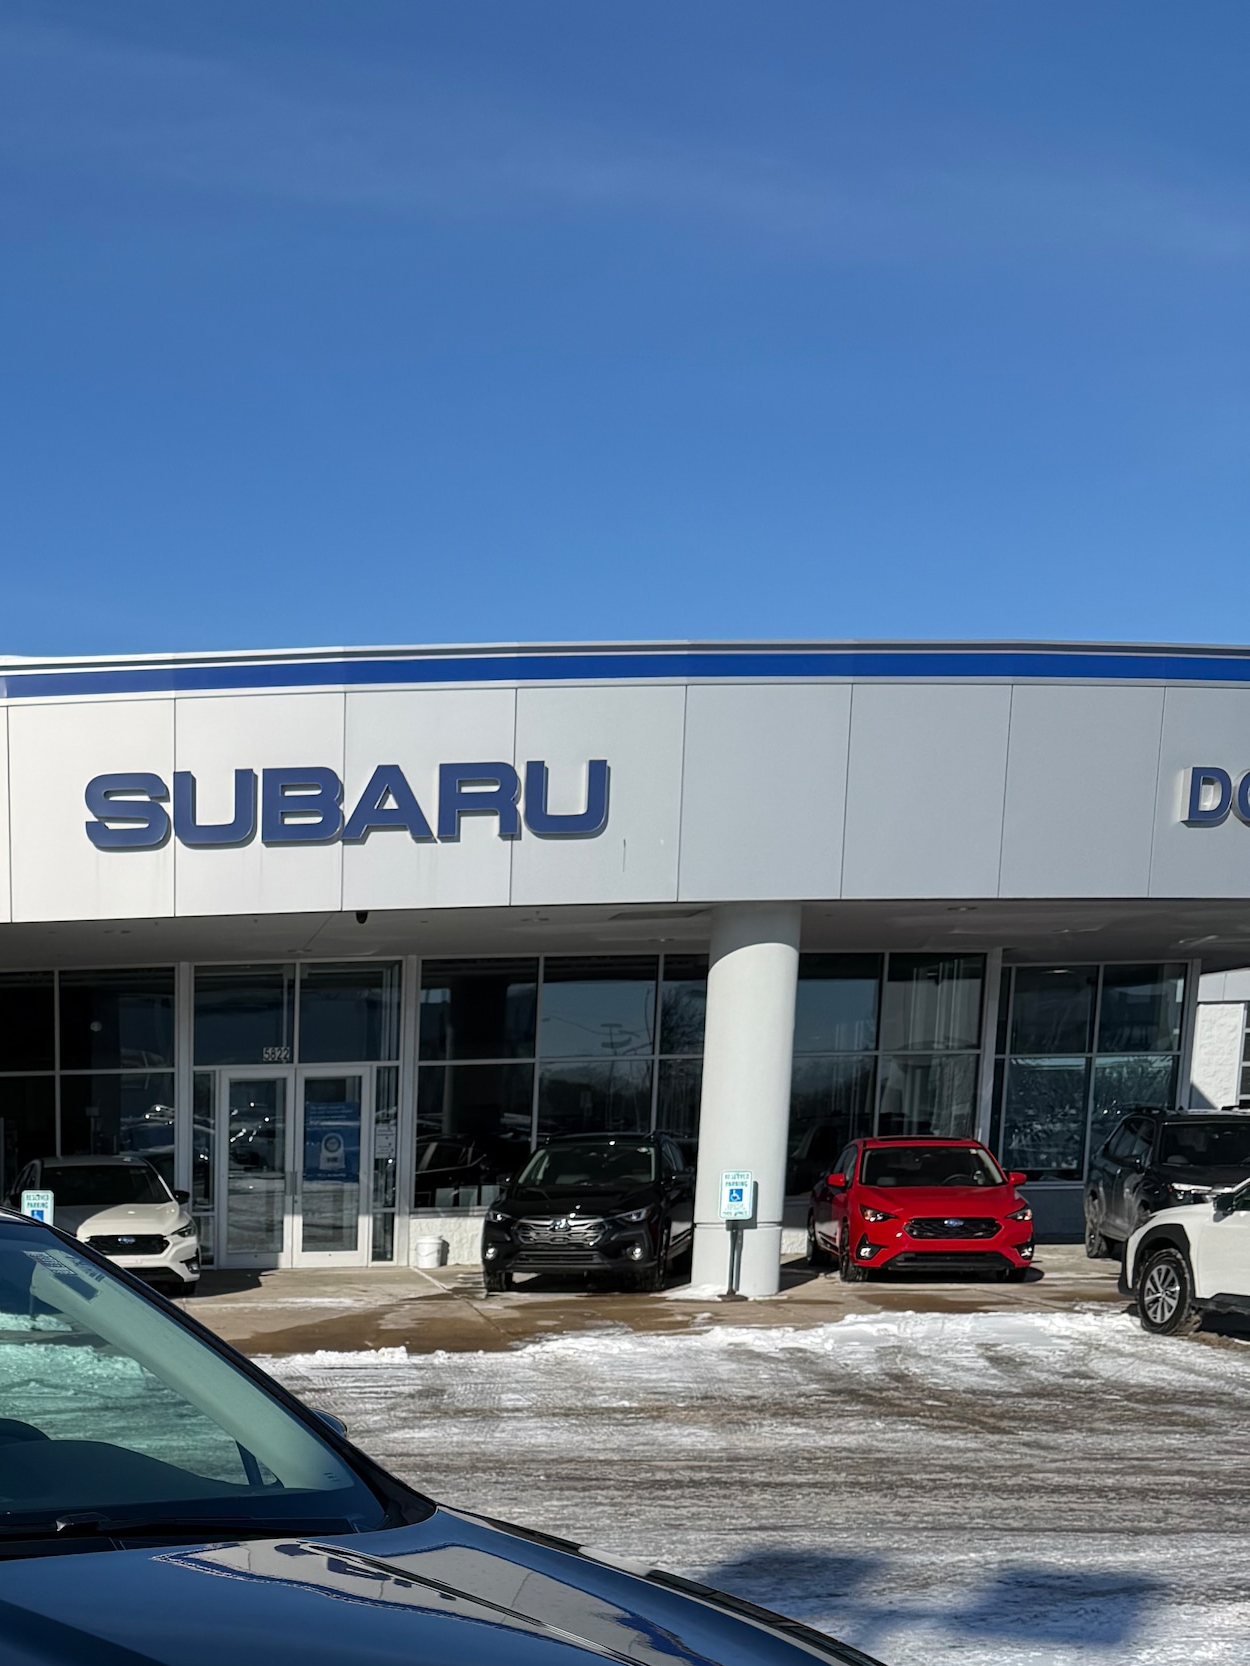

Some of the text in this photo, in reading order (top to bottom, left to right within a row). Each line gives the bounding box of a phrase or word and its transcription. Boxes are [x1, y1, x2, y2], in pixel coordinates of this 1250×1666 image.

[85, 759, 609, 850] SUBARU
[1183, 766, 1250, 826] D
[263, 1047, 288, 1060] 5822
